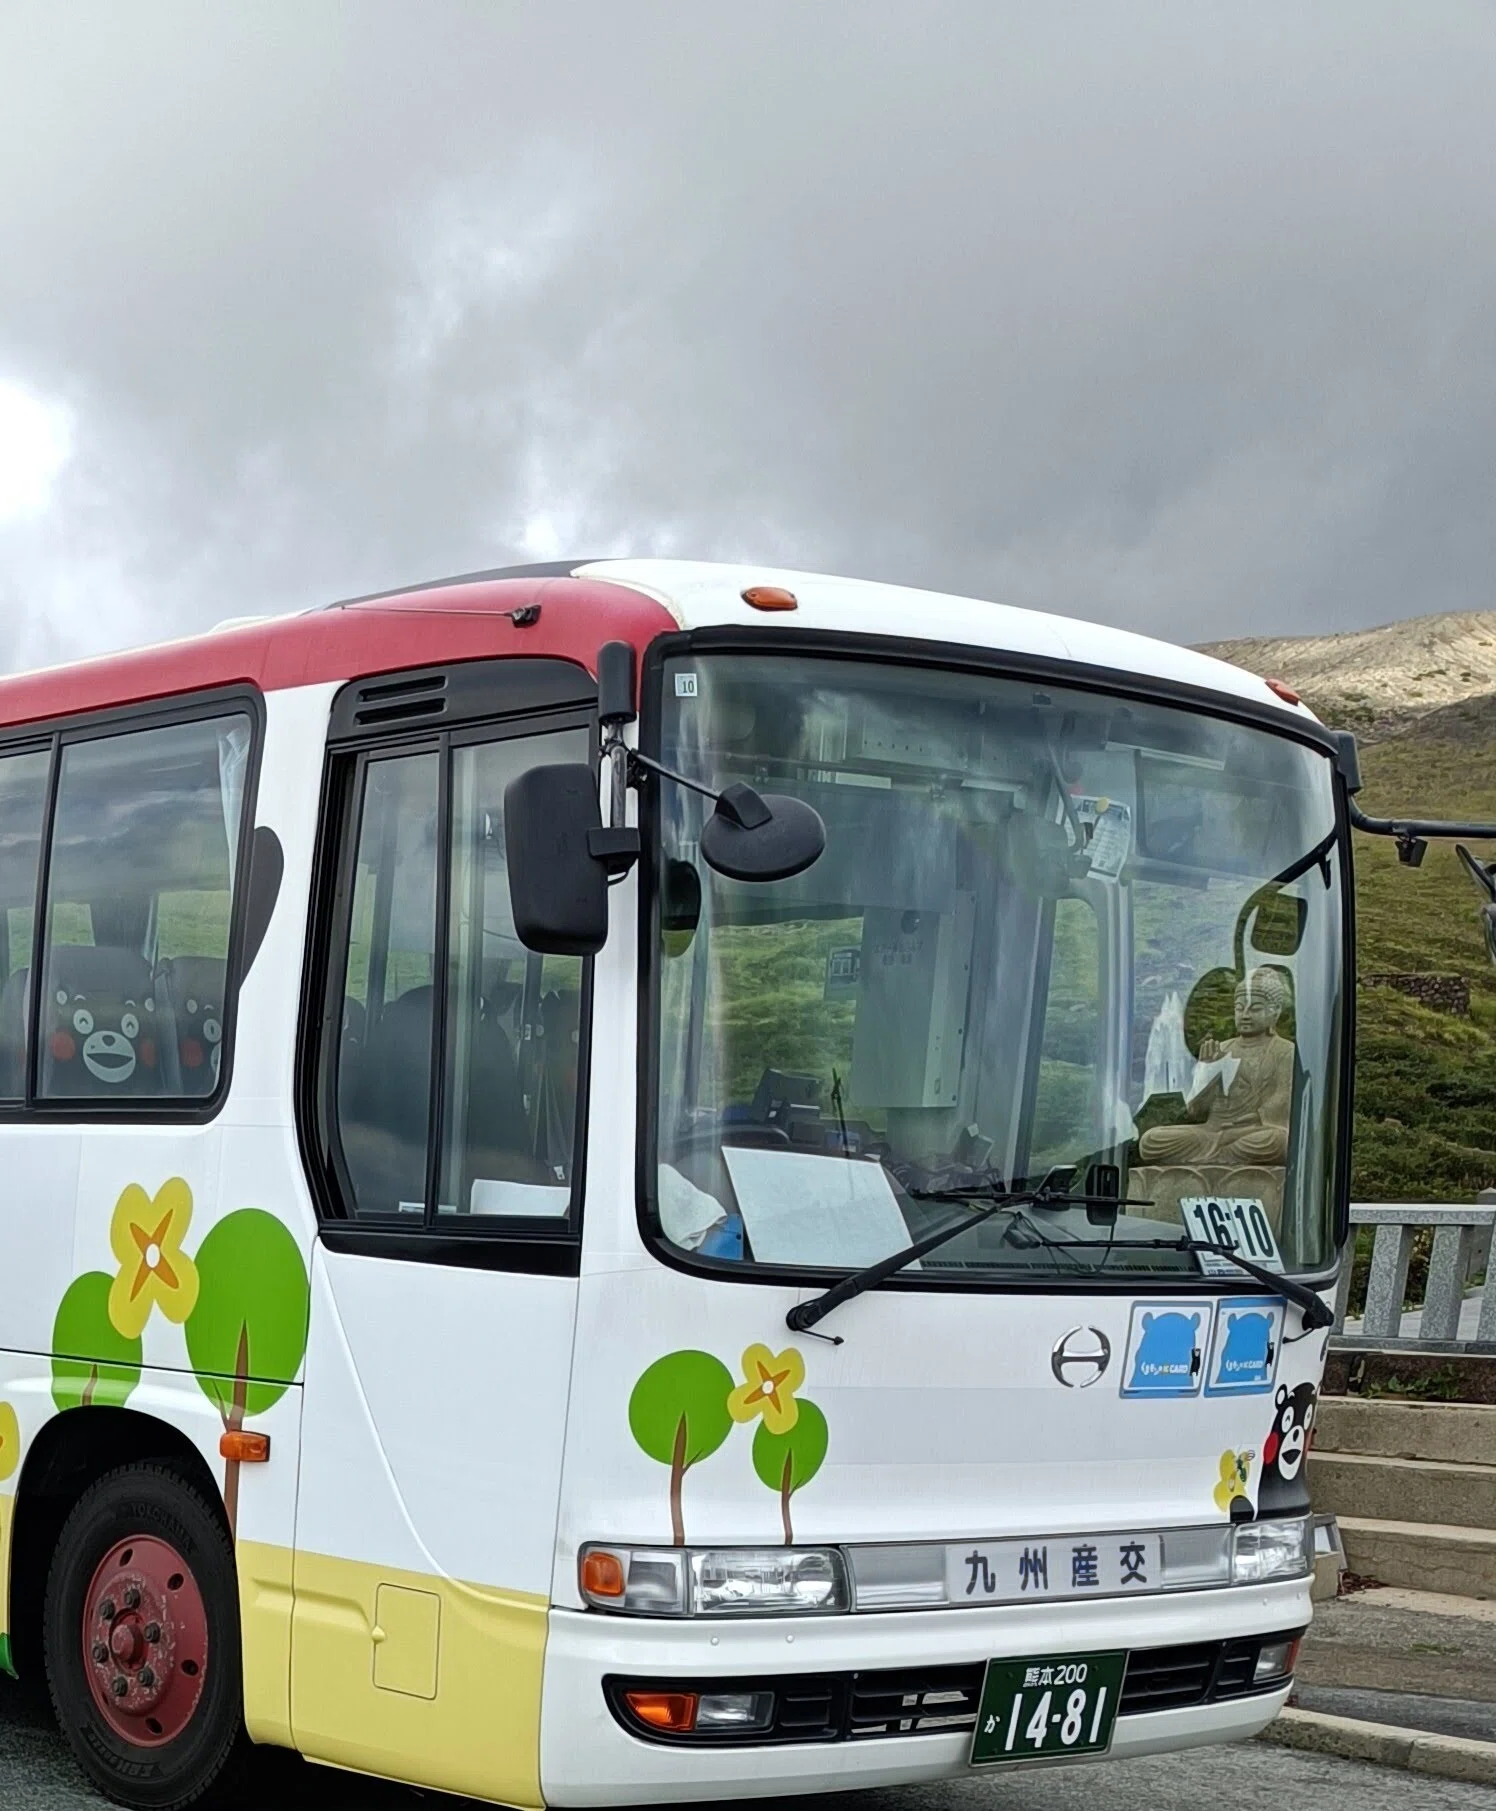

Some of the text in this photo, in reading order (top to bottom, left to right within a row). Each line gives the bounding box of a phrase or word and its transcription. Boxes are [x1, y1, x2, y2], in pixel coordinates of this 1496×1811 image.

[683, 680, 694, 694] 10
[964, 1541, 1148, 1595] 九州産交
[984, 1686, 1108, 1751] か 14-81
